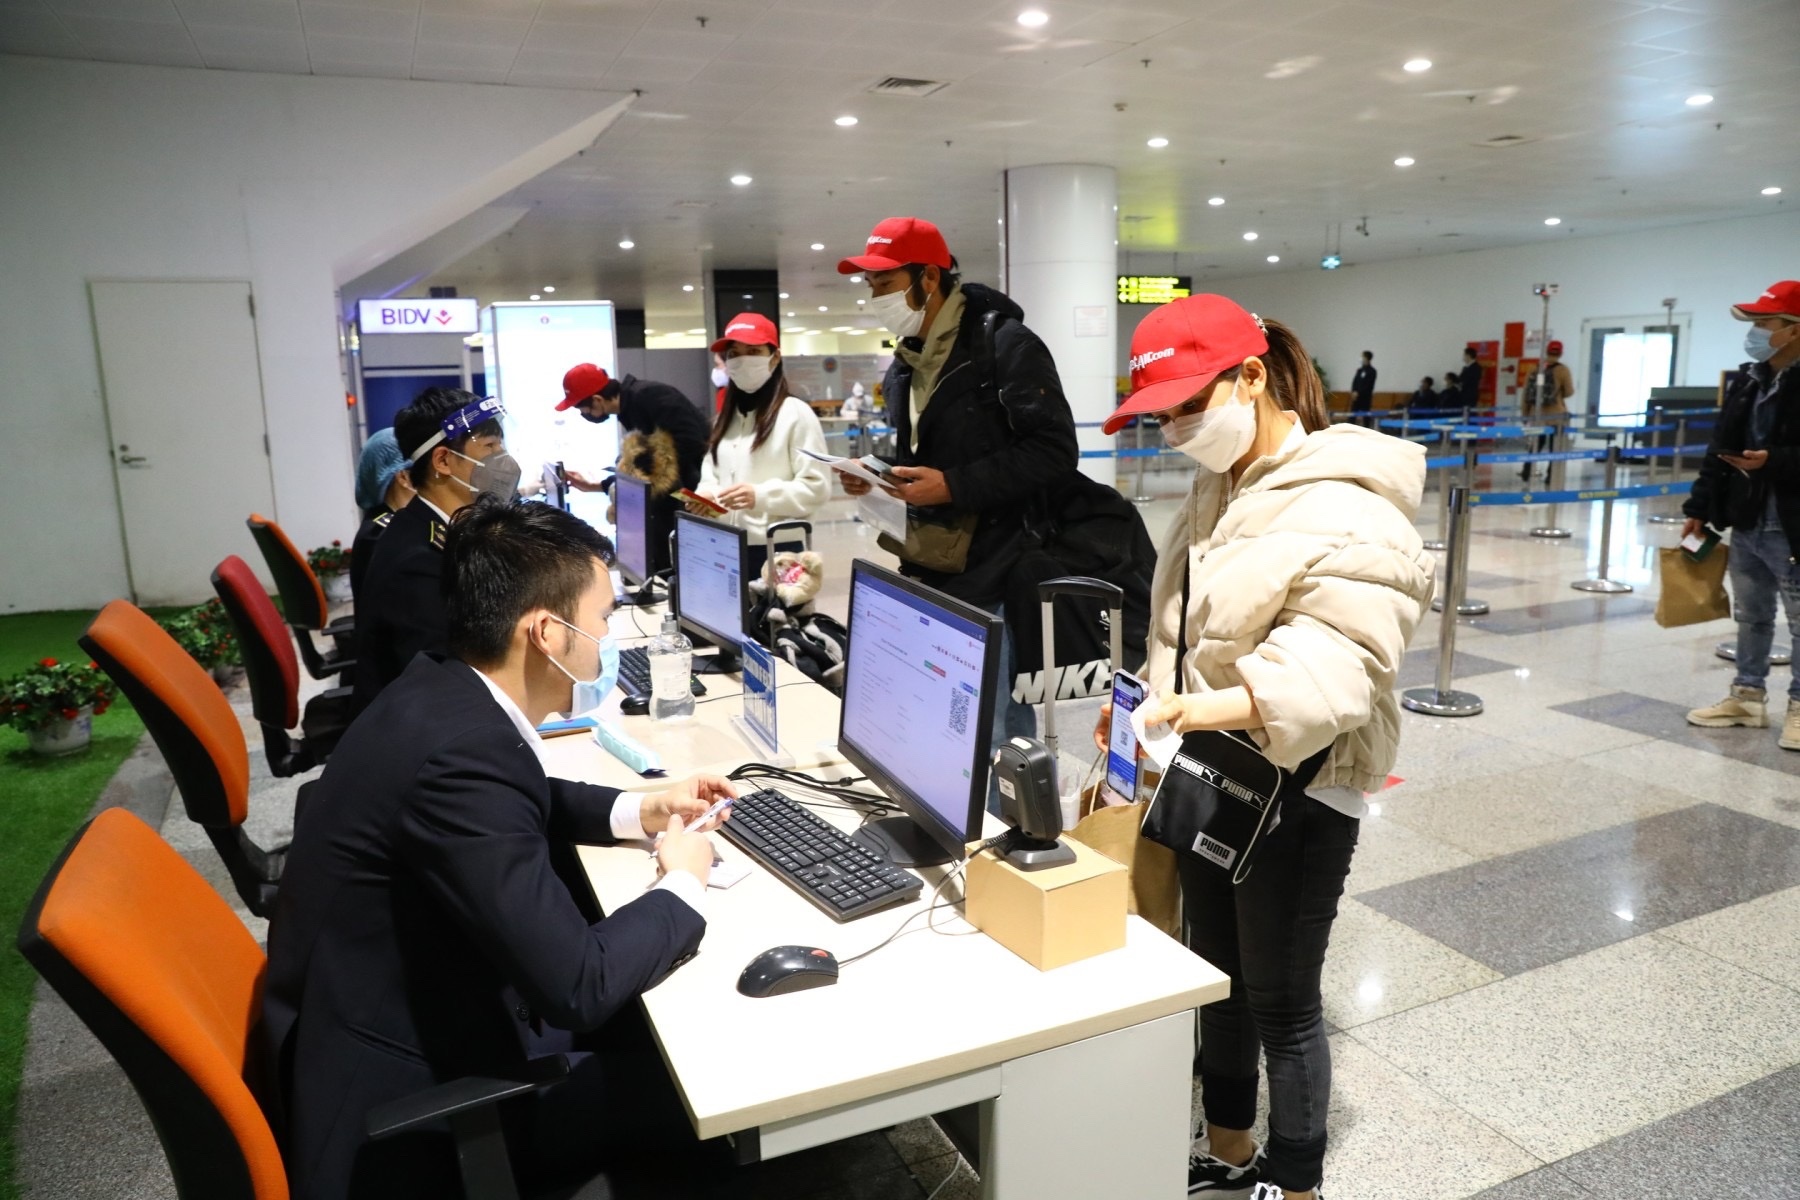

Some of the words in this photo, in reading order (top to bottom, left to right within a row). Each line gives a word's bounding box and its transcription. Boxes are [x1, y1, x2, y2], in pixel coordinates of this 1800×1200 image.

[381, 308, 431, 325] BIDV
[1173, 753, 1205, 777] PUMA
[1220, 778, 1254, 802] PUMA
[1200, 837, 1231, 860] PUMA
